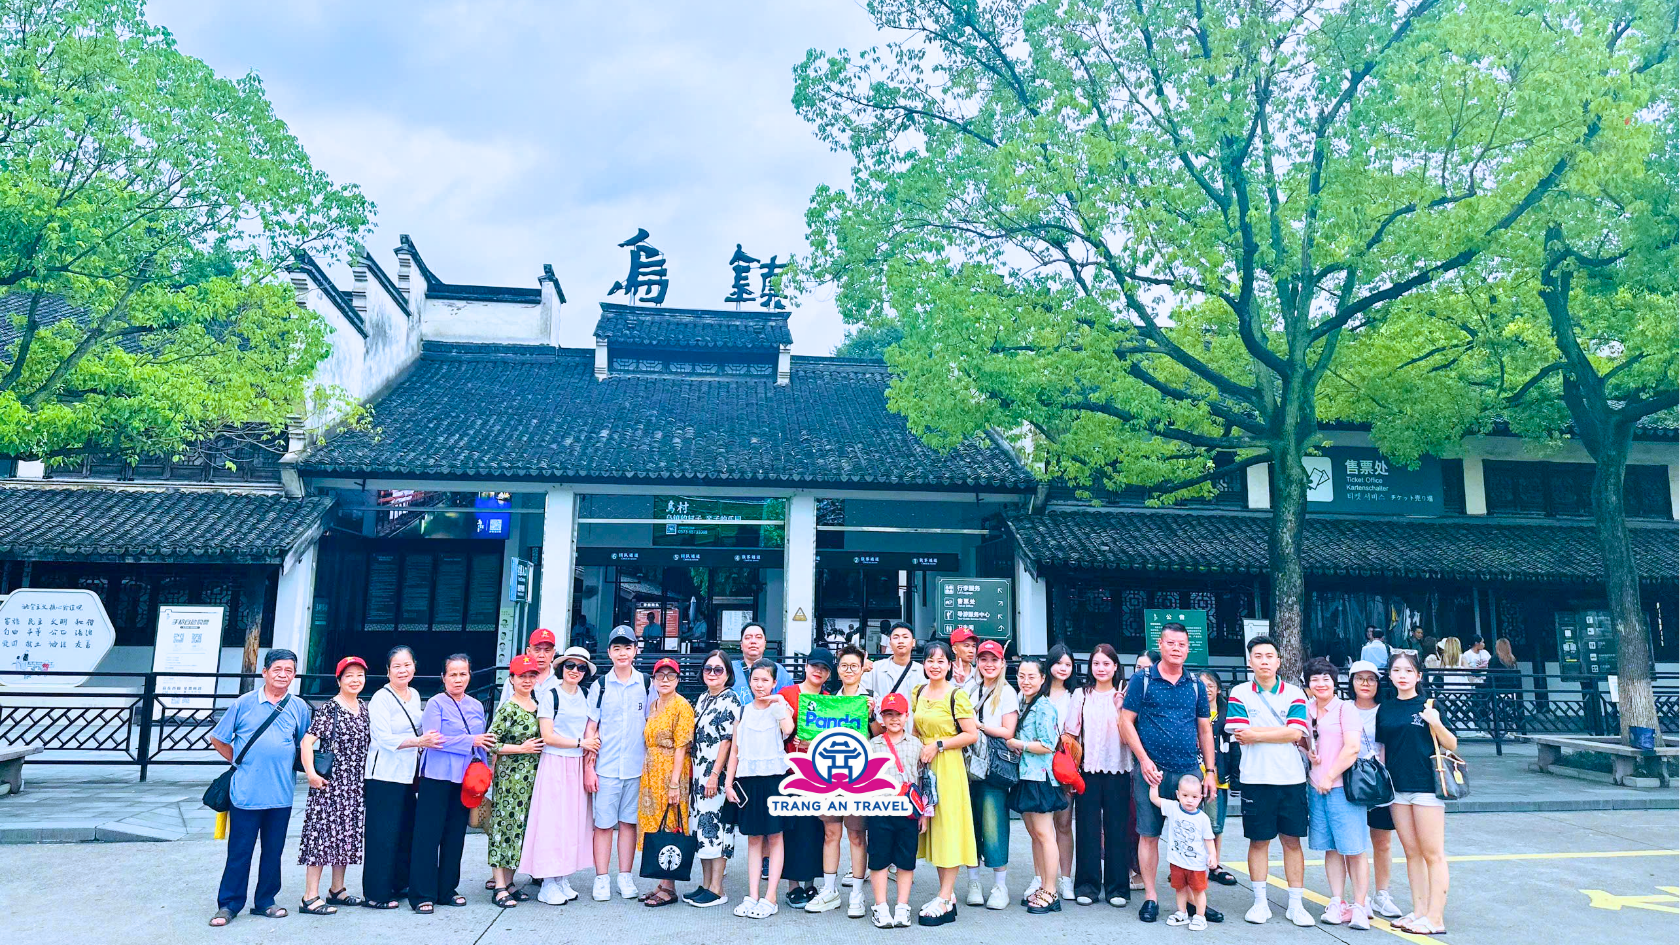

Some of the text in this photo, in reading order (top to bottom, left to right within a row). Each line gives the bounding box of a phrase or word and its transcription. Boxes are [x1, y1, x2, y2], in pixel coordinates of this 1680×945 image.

[1345, 460, 1389, 475] 售票处
[637, 702, 643, 711] B
[805, 711, 861, 729] Panda
